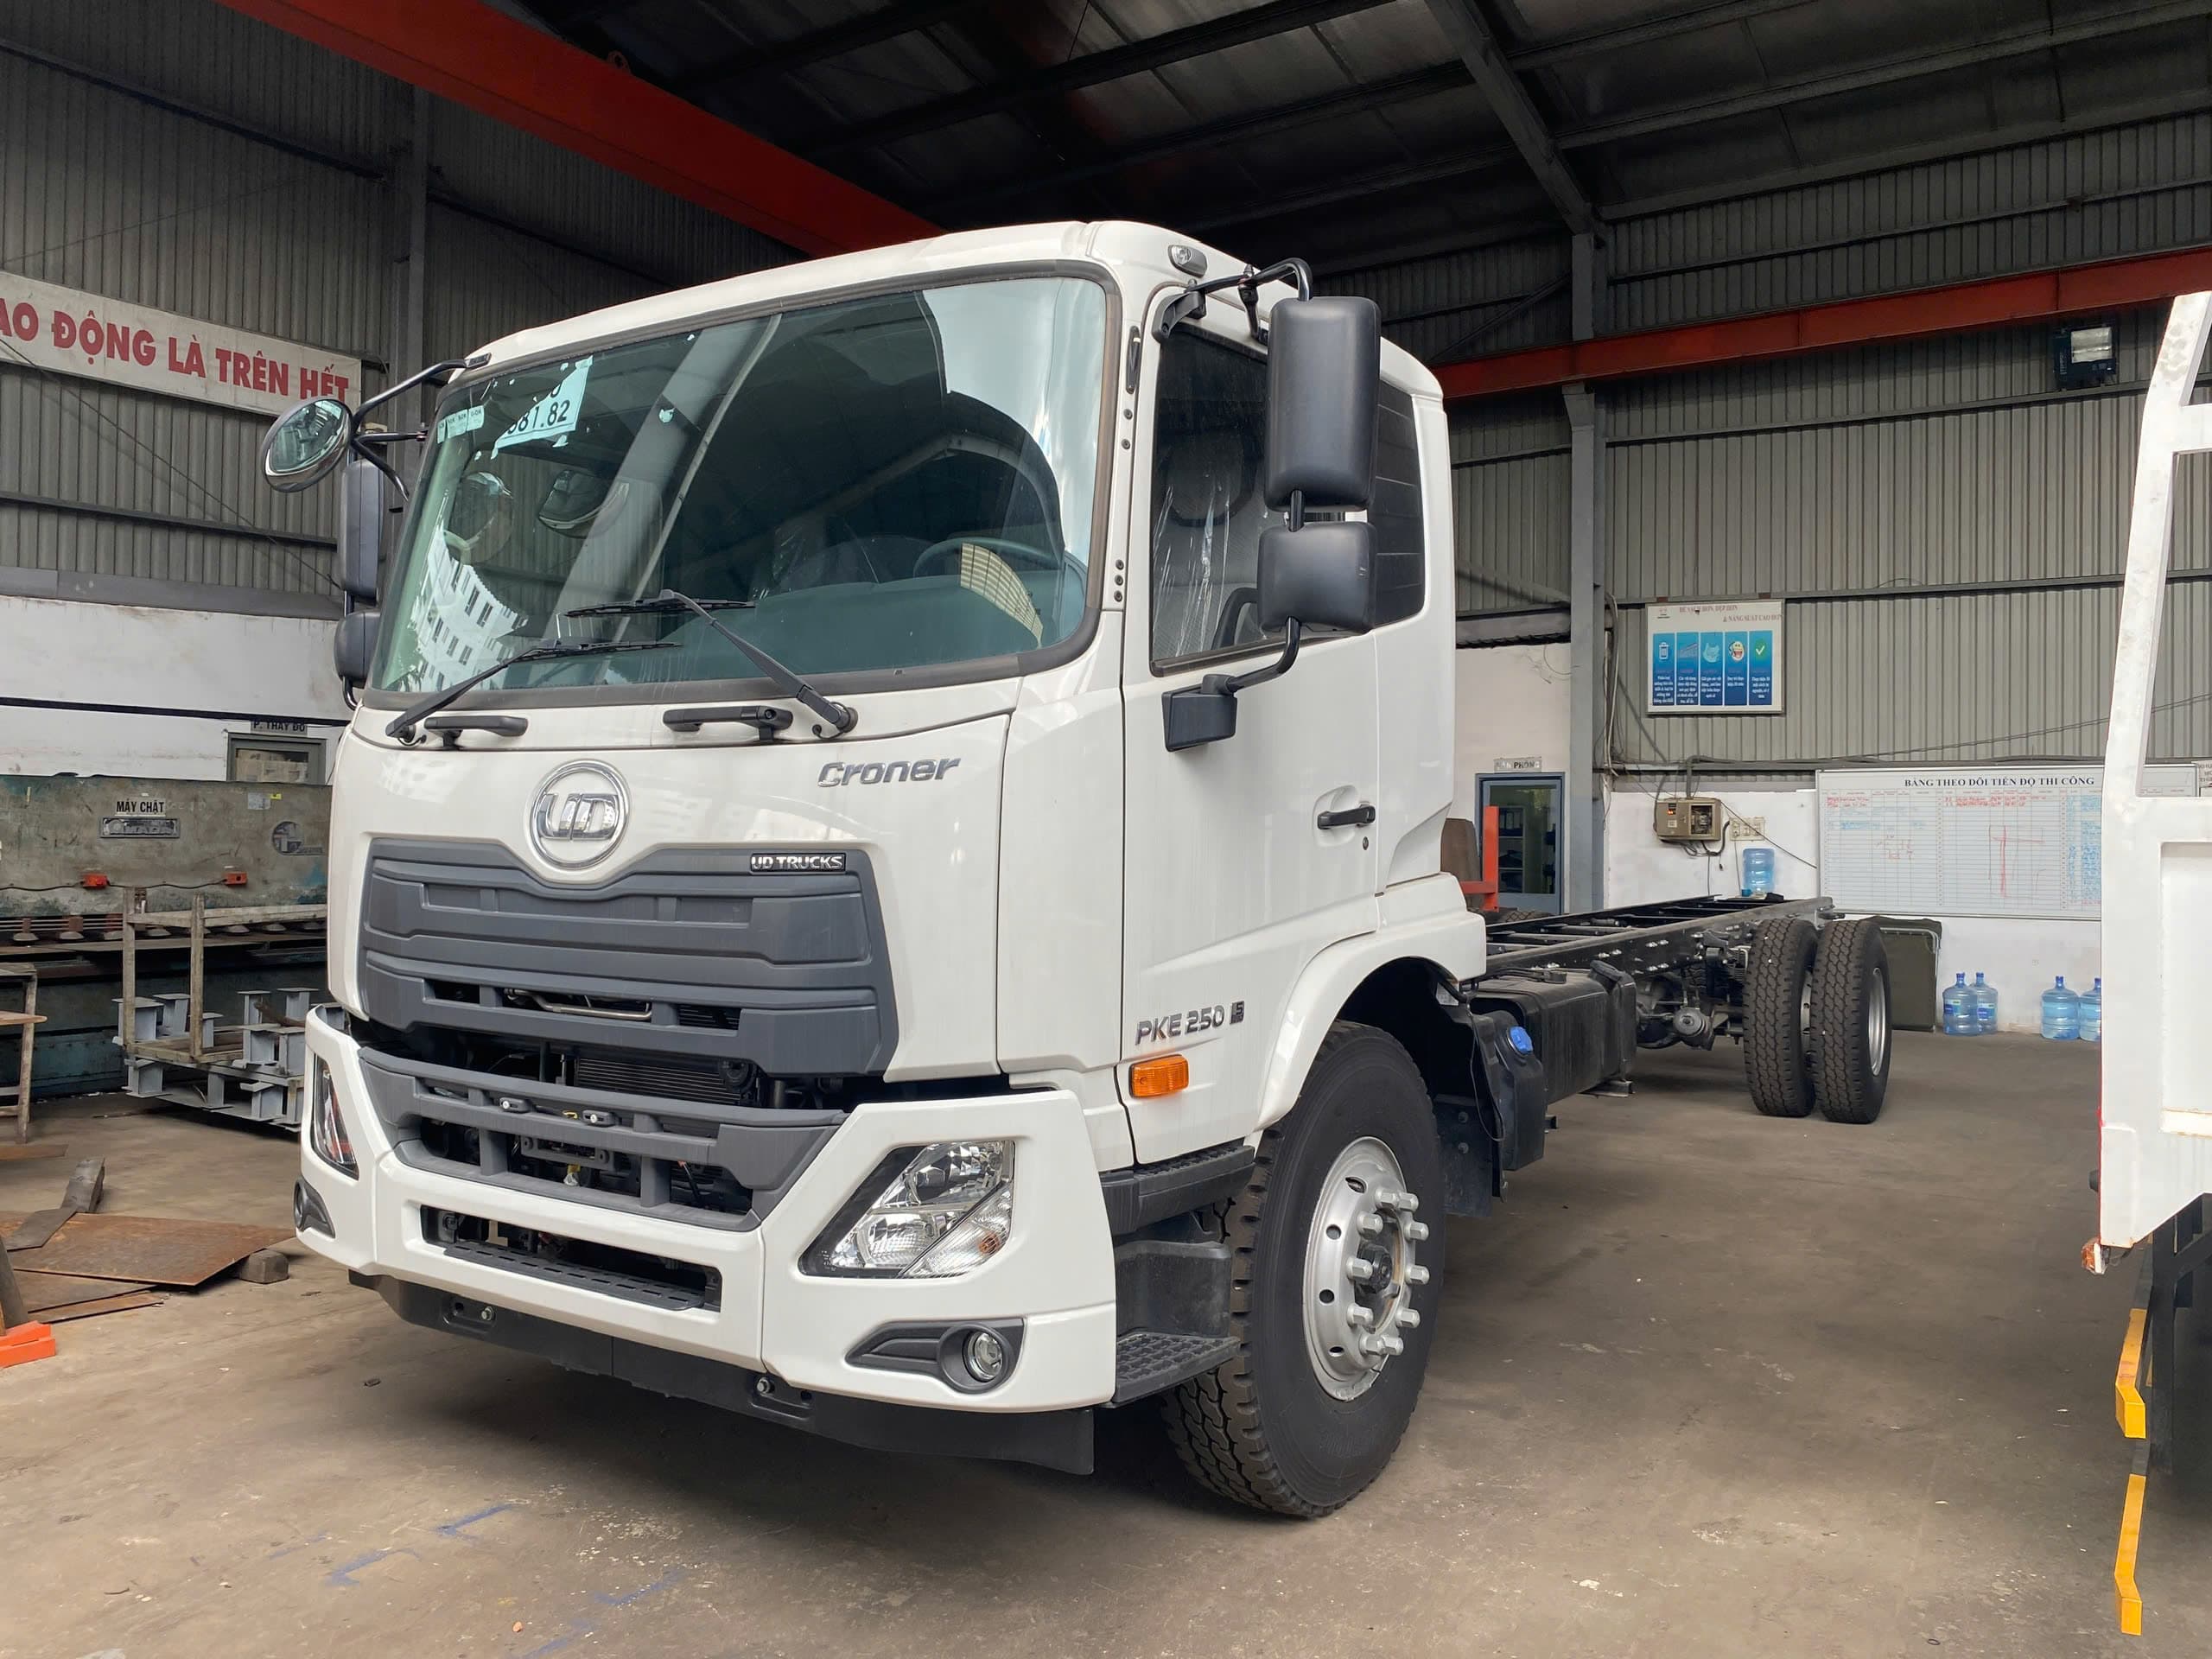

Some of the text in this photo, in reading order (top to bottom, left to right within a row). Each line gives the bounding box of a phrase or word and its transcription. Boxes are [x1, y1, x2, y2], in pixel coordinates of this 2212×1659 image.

[51, 310, 156, 366] ĐỘNG
[168, 334, 207, 378] LÀ
[215, 350, 289, 396] TRÊN
[300, 364, 349, 402] HẾT
[817, 758, 961, 788] Croner
[1936, 779, 1966, 787] THEO
[2040, 778, 2058, 786] THI
[2061, 776, 2094, 785] CÔNG
[116, 798, 137, 812] MÁY
[538, 792, 619, 842] UD
[751, 855, 842, 869] UD TRUCKS
[1135, 1013, 1182, 1046] PKE
[1185, 1005, 1225, 1035] 250
